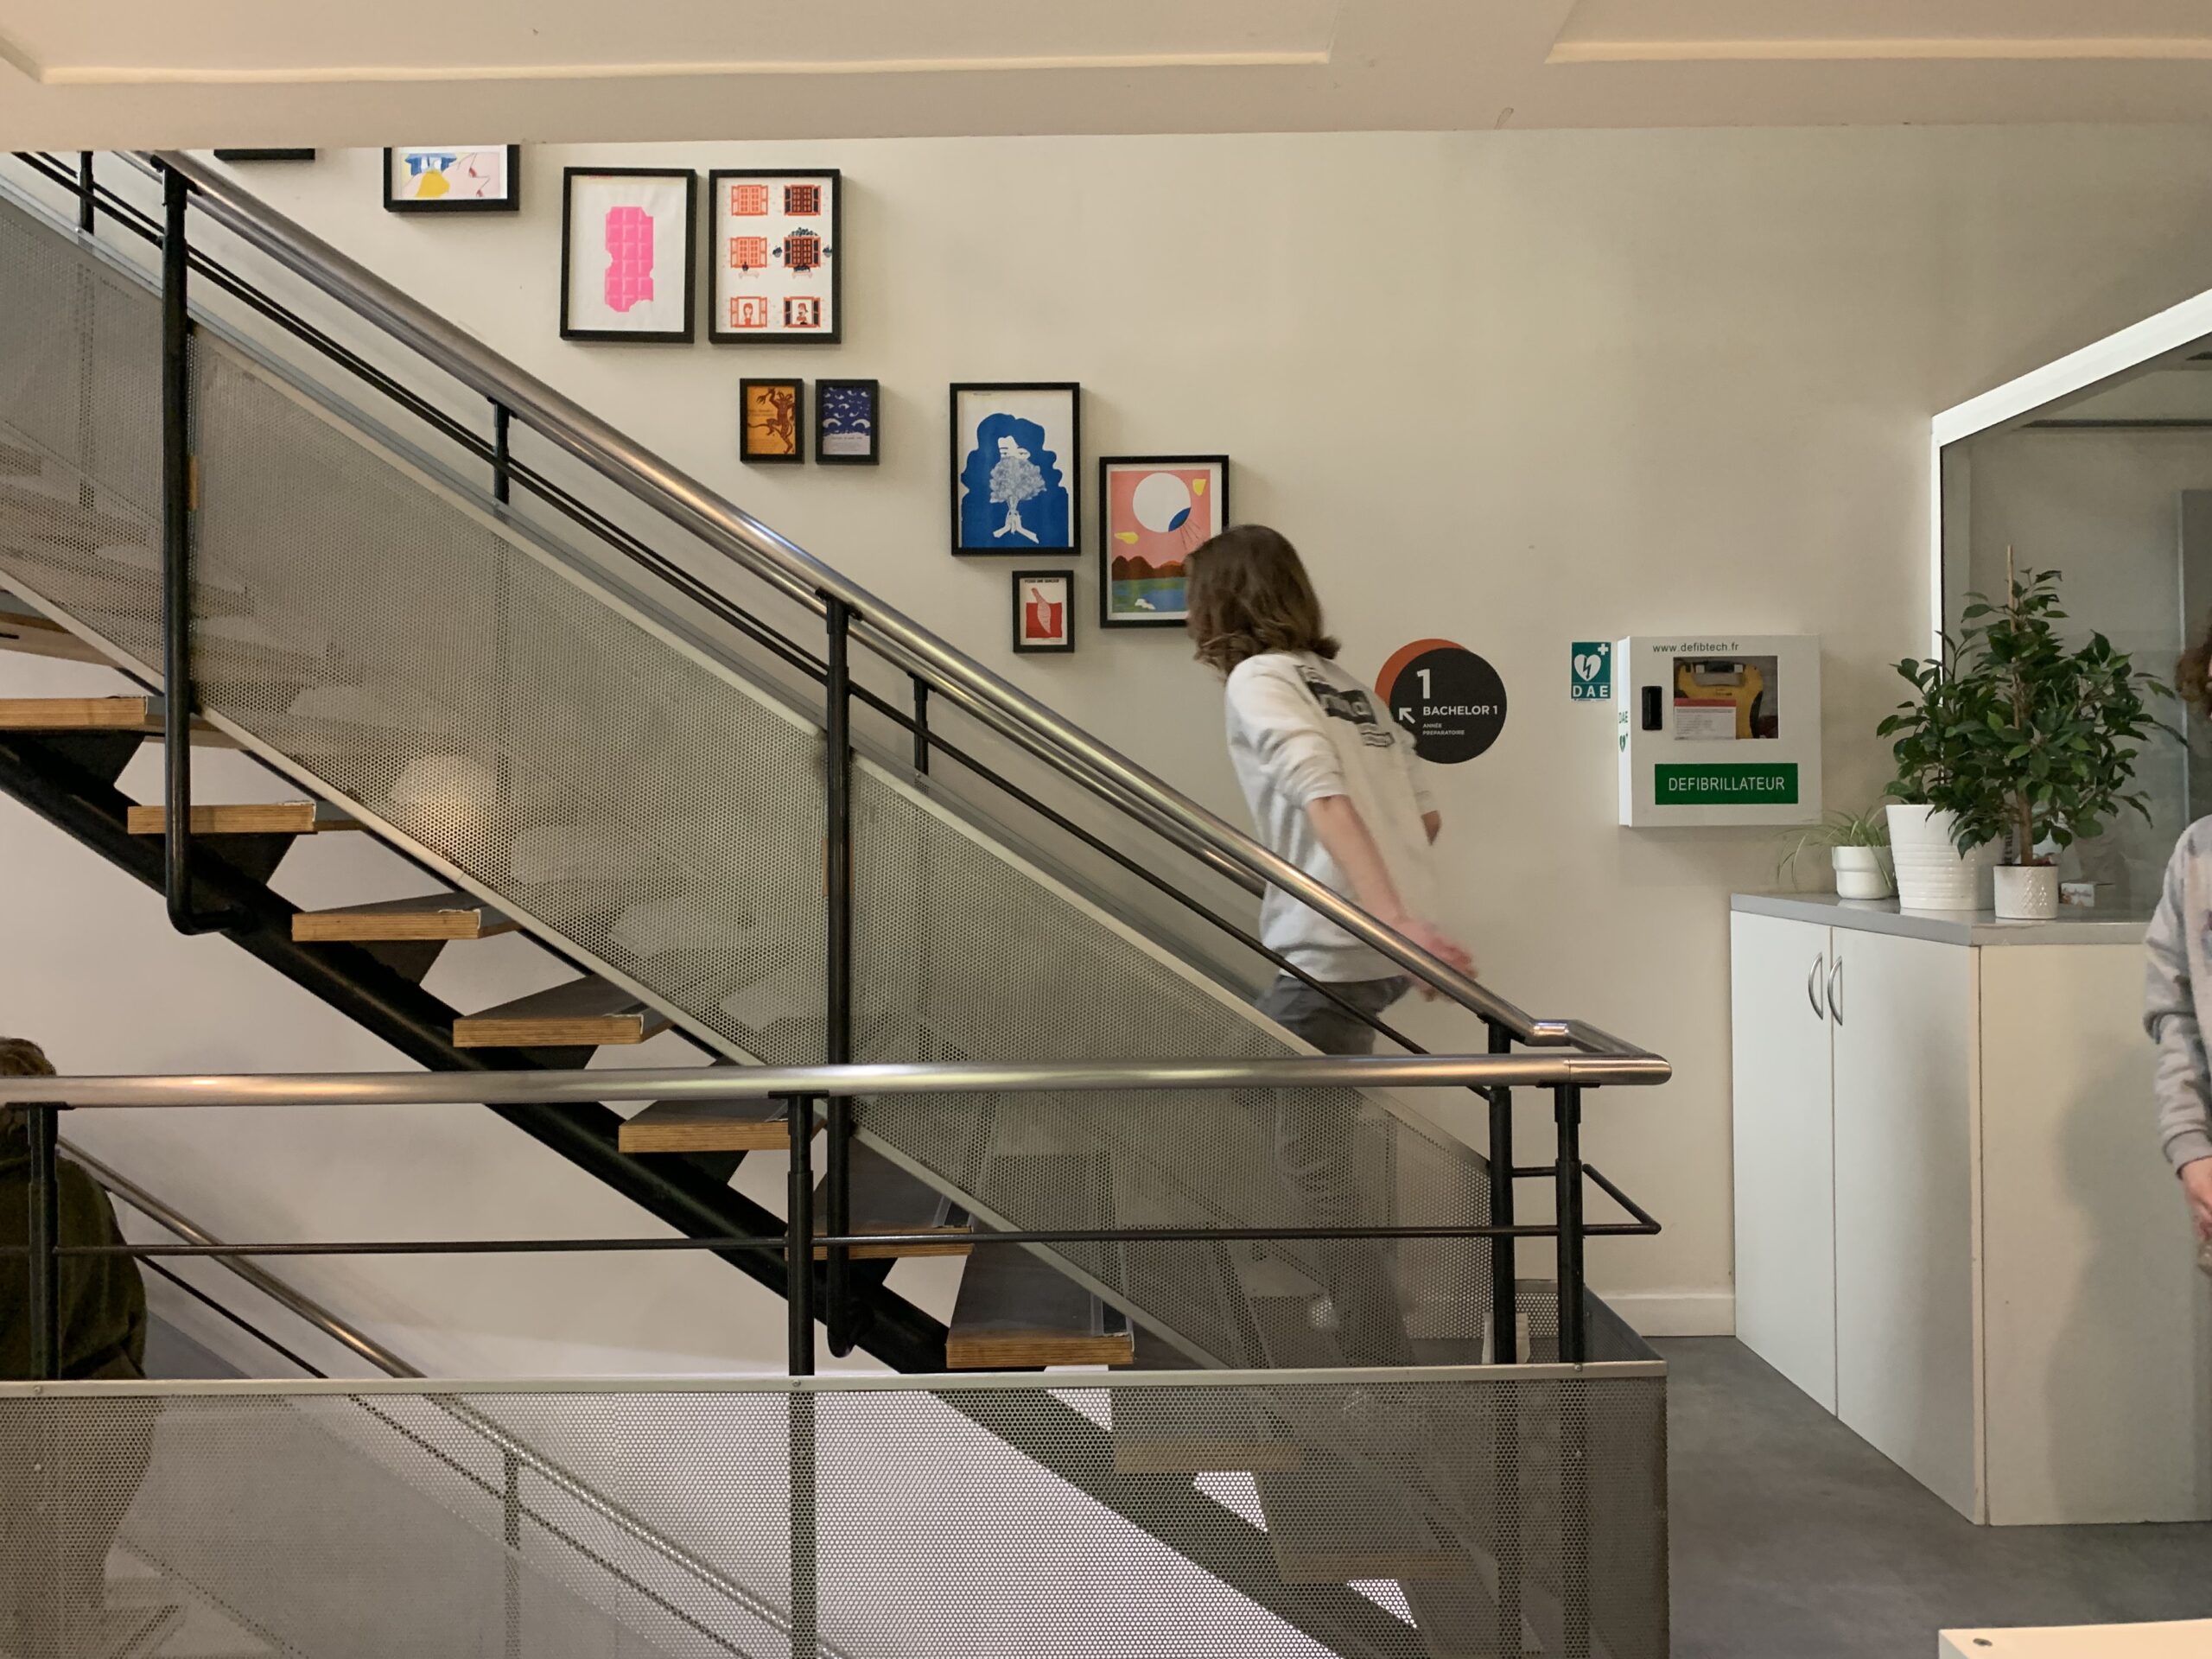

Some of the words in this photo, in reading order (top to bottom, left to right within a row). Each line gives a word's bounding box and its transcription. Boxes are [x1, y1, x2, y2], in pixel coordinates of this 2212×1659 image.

[1652, 642, 1739, 652] www.defibtech.fr
[1416, 669, 1431, 699] 1
[1572, 684, 1609, 697] DAE
[1423, 705, 1490, 716] BACHELOR
[1492, 705, 1498, 715] 1
[1669, 776, 1785, 791] DEFIBRILLATEUR
